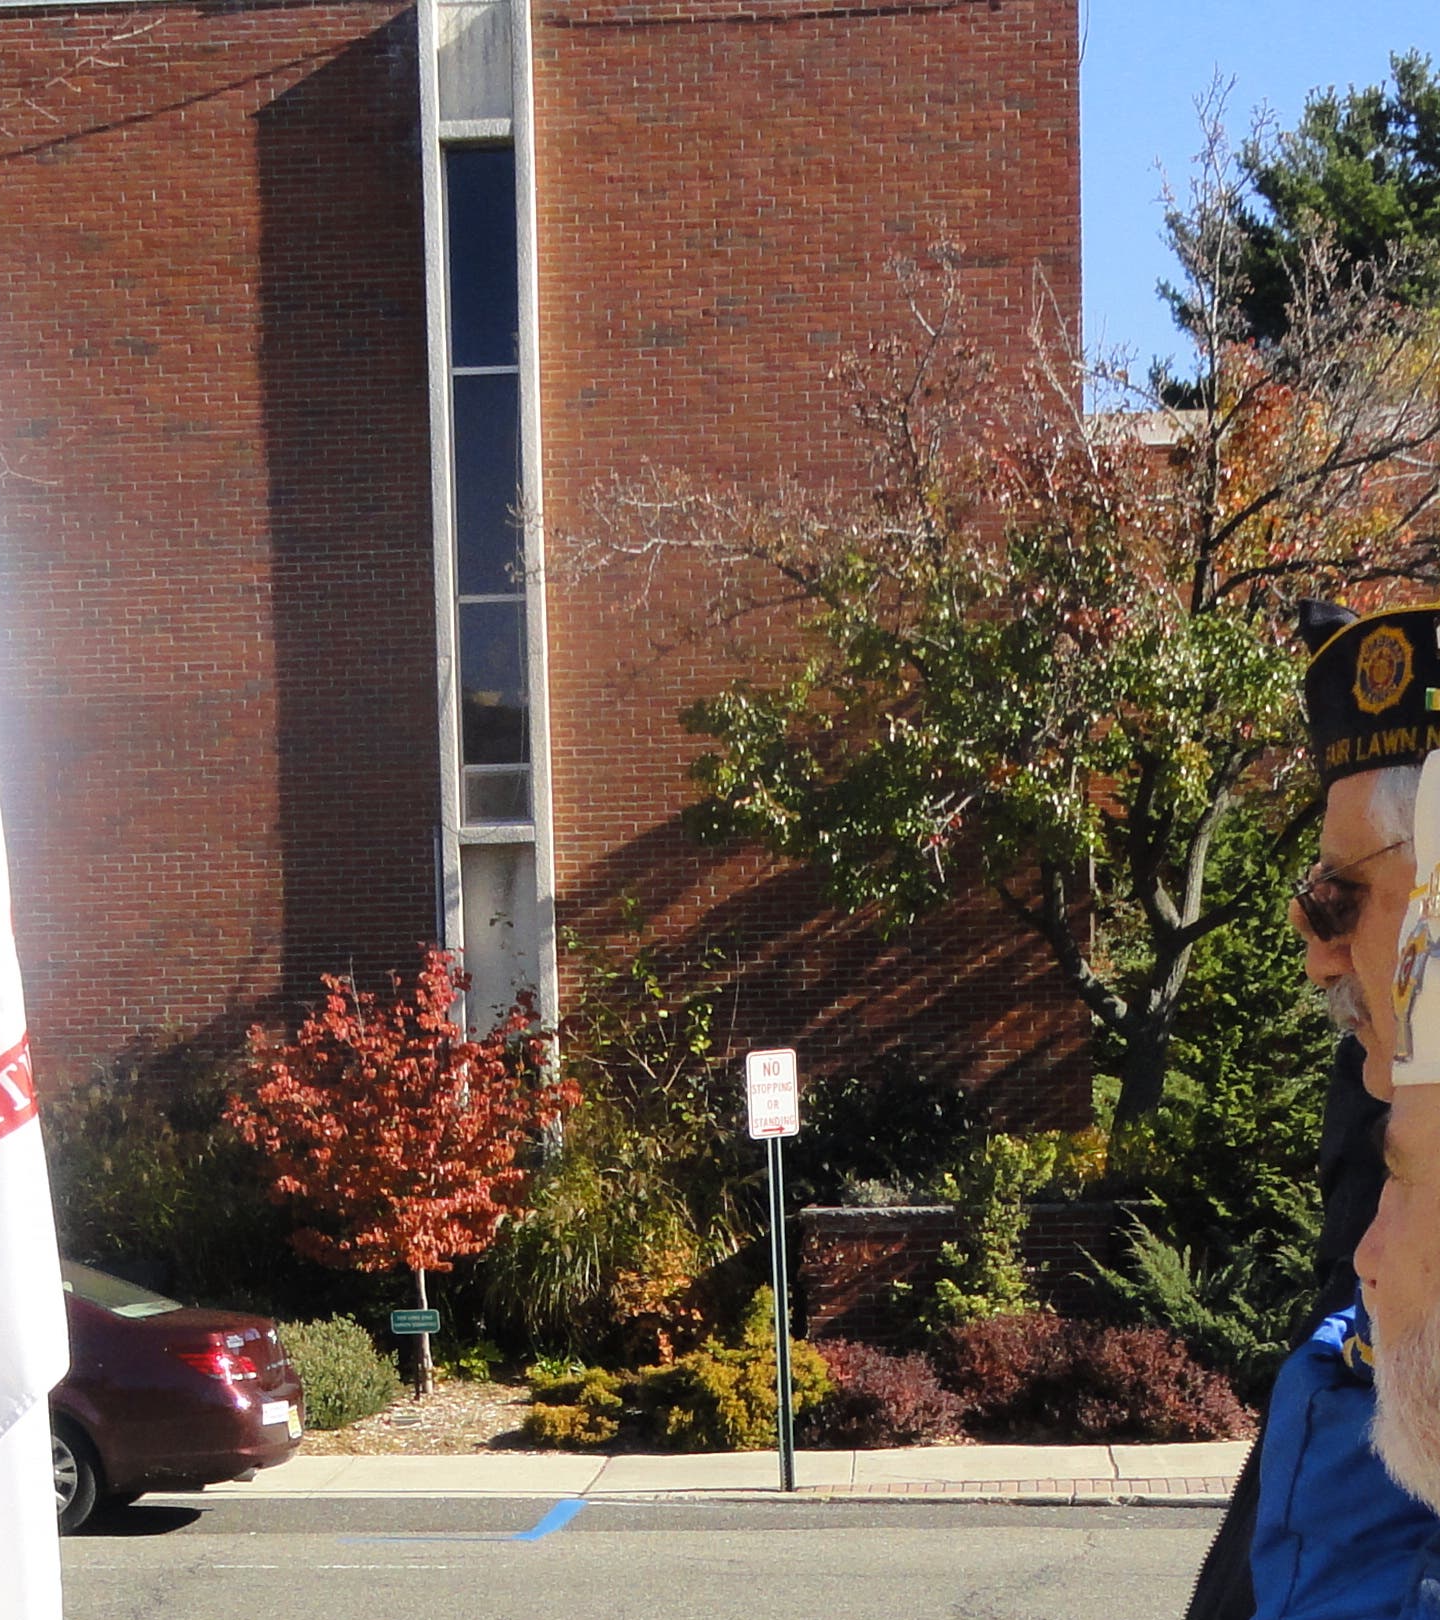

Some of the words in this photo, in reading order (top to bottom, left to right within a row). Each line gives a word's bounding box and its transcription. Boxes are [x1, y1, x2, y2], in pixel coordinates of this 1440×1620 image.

[762, 1061, 780, 1077] NO
[752, 1081, 792, 1095] STOPPING
[767, 1099, 779, 1110] OR
[754, 1114, 796, 1129] STANDING
